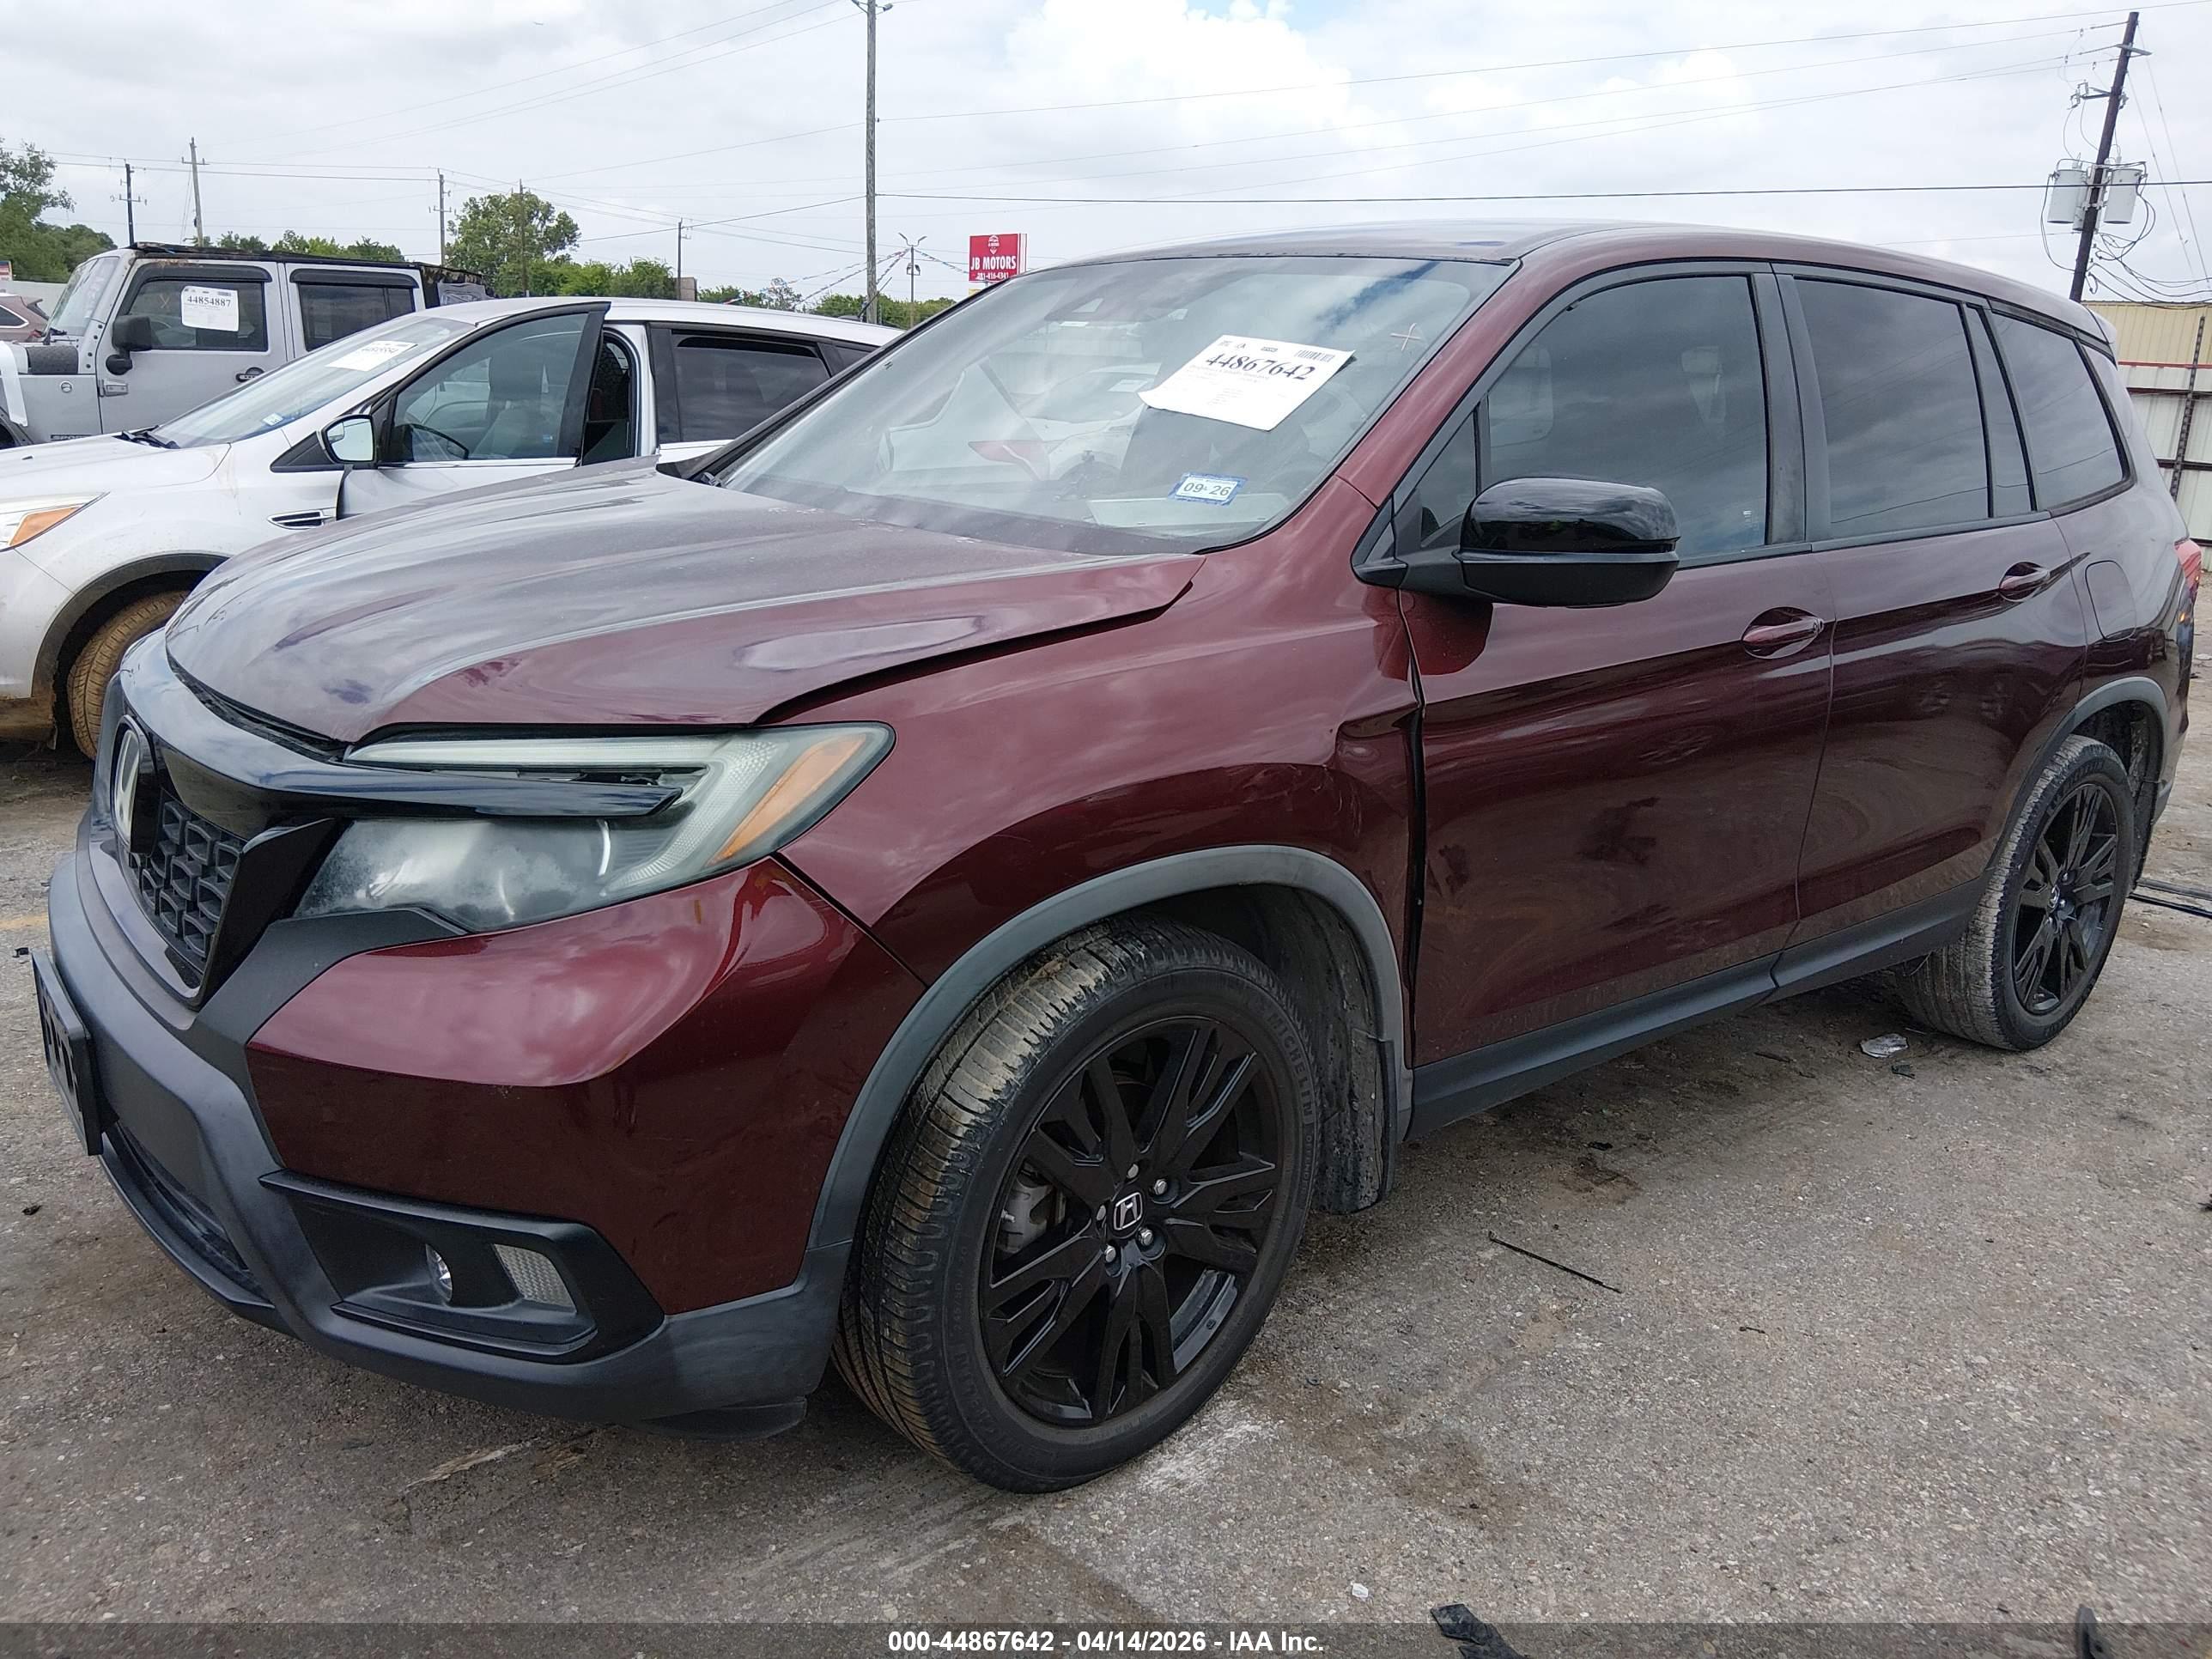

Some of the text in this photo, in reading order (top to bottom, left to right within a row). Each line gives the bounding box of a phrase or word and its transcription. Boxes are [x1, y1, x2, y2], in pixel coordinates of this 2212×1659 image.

[971, 255, 1017, 270] JB MOTORS
[187, 295, 231, 307] 44854887
[1205, 352, 1316, 380] 44867642
[1183, 482, 1231, 496] 09 26
[1267, 1012, 1314, 1117] MICHELIN
